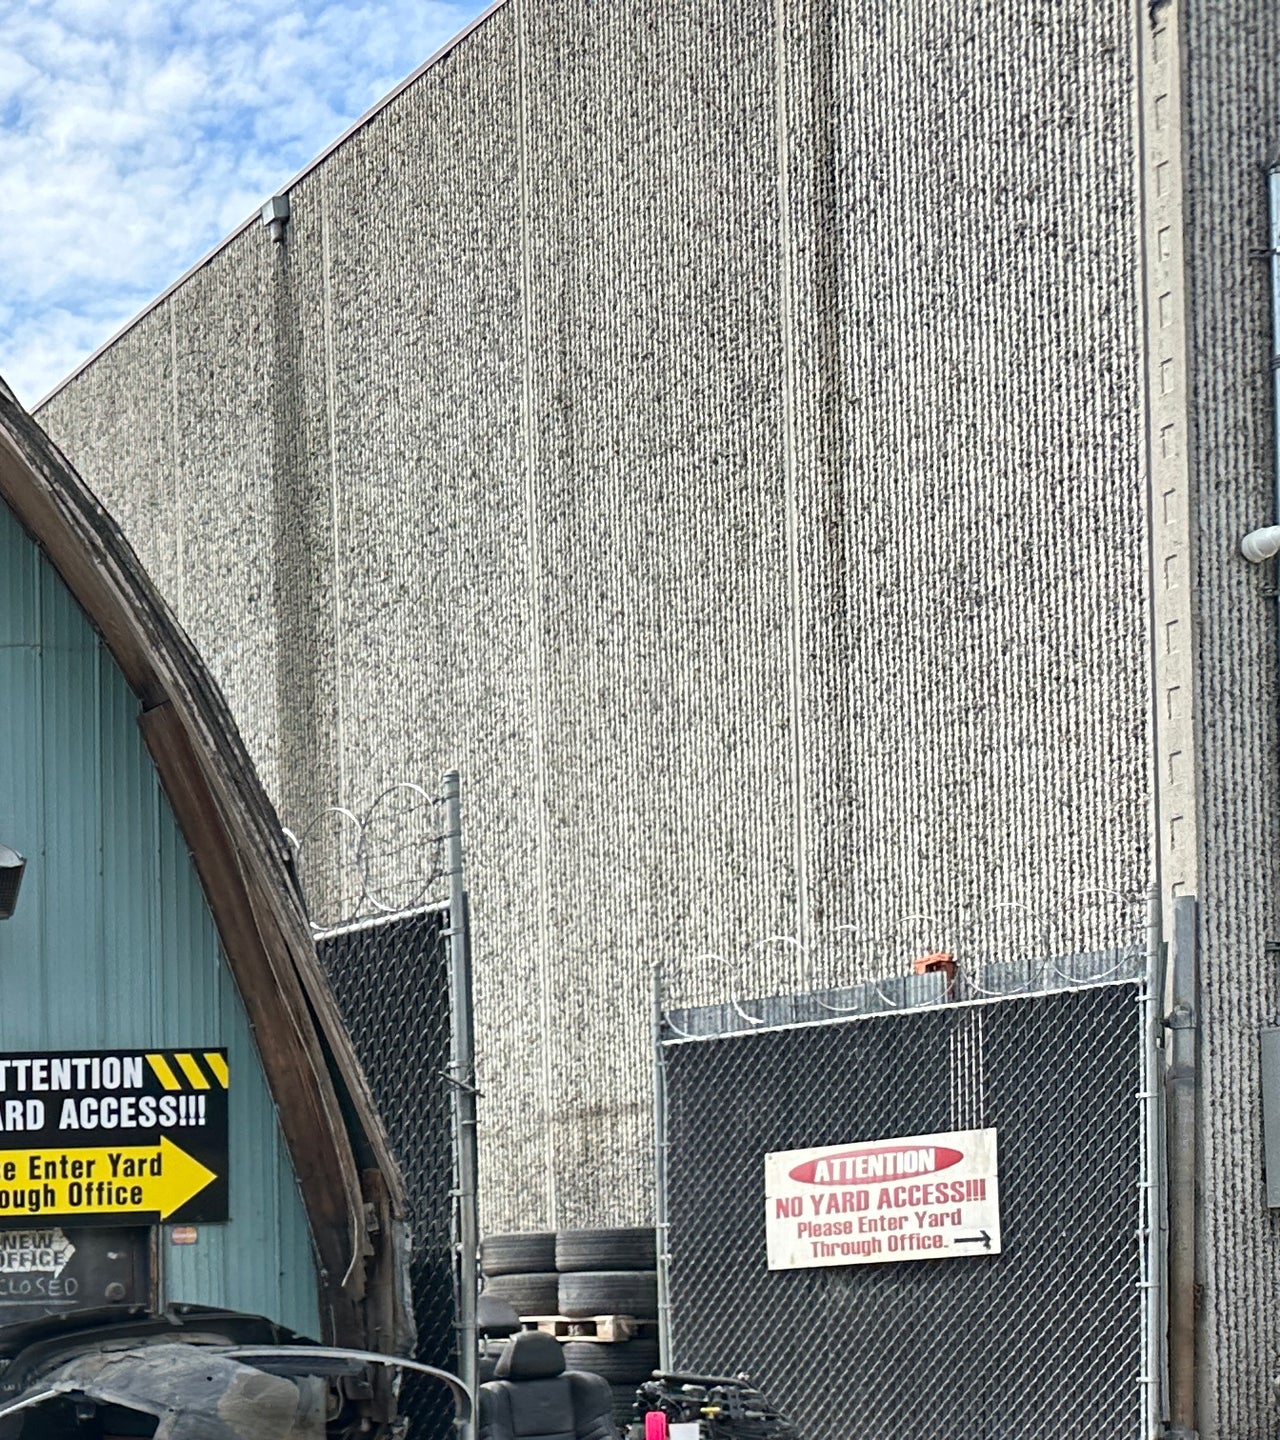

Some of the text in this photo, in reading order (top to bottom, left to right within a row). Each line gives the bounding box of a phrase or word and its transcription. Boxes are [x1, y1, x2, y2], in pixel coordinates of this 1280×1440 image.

[58, 1095, 206, 1129] ACCESS!!!
[28, 1154, 96, 1180] Enter
[107, 1152, 163, 1178] Yard
[813, 1147, 936, 1183] ATTENTION
[67, 1182, 144, 1207] Office
[775, 1179, 987, 1219] NO YARD ACCESS!!!
[797, 1208, 962, 1239] Please Enter Yard
[1, 1232, 53, 1249] NEW
[810, 1237, 882, 1258] Through
